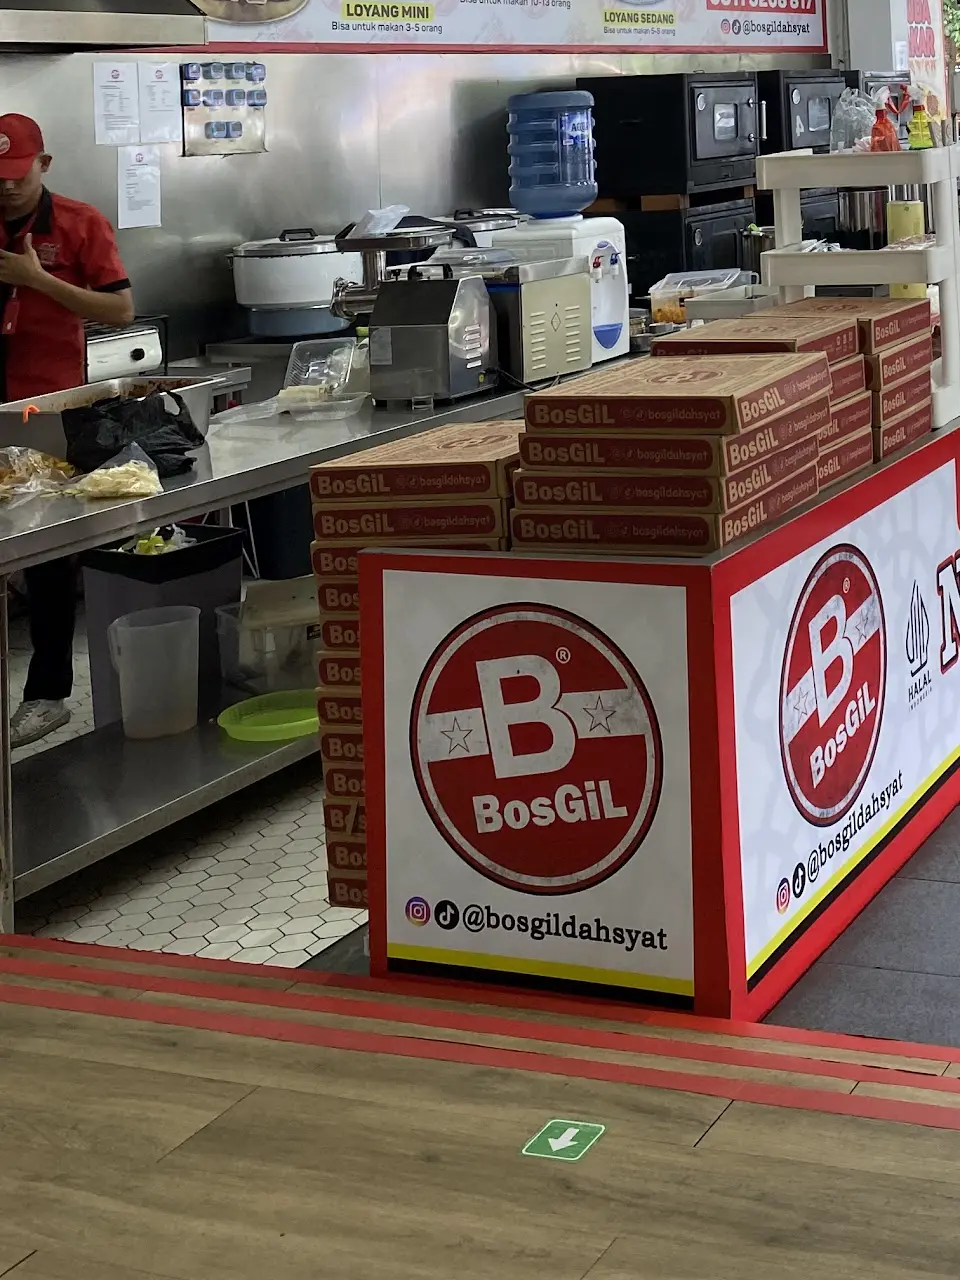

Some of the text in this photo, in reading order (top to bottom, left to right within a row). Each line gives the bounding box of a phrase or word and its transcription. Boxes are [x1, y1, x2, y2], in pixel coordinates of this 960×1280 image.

[346, 4, 429, 18] LOYANG MINI
[552, 0, 571, 9] orang
[332, 22, 442, 34] Bisa untuk makan 3-5 orang
[604, 12, 674, 24] LOYANG SEDANG
[743, 20, 810, 36] @bosgildahsyat
[604, 26, 616, 34] Bisa
[875, 320, 900, 340] BosGiL
[884, 354, 906, 378] BosGiL
[534, 404, 614, 424] BosGiL
[740, 387, 785, 422] BosGiL
[884, 392, 906, 414] BosGiL
[730, 428, 778, 466] BosGiL
[884, 428, 906, 450] BosGiL
[528, 443, 604, 462] BosGiL
[318, 474, 390, 494] BosGiL
[523, 481, 602, 501] BosGiL
[728, 464, 772, 503] BosGiL
[321, 513, 394, 534] BosGiL
[520, 520, 600, 539] BosGiL
[725, 501, 768, 542] BosGiL
[808, 594, 853, 728] B
[908, 670, 931, 702] HALAL
[476, 654, 576, 779] B
[810, 680, 876, 789] BosGiL
[472, 779, 628, 834] BosGiL
[807, 769, 904, 882] @bosgildahsyat
[462, 903, 668, 952] @bosgildahsyat
